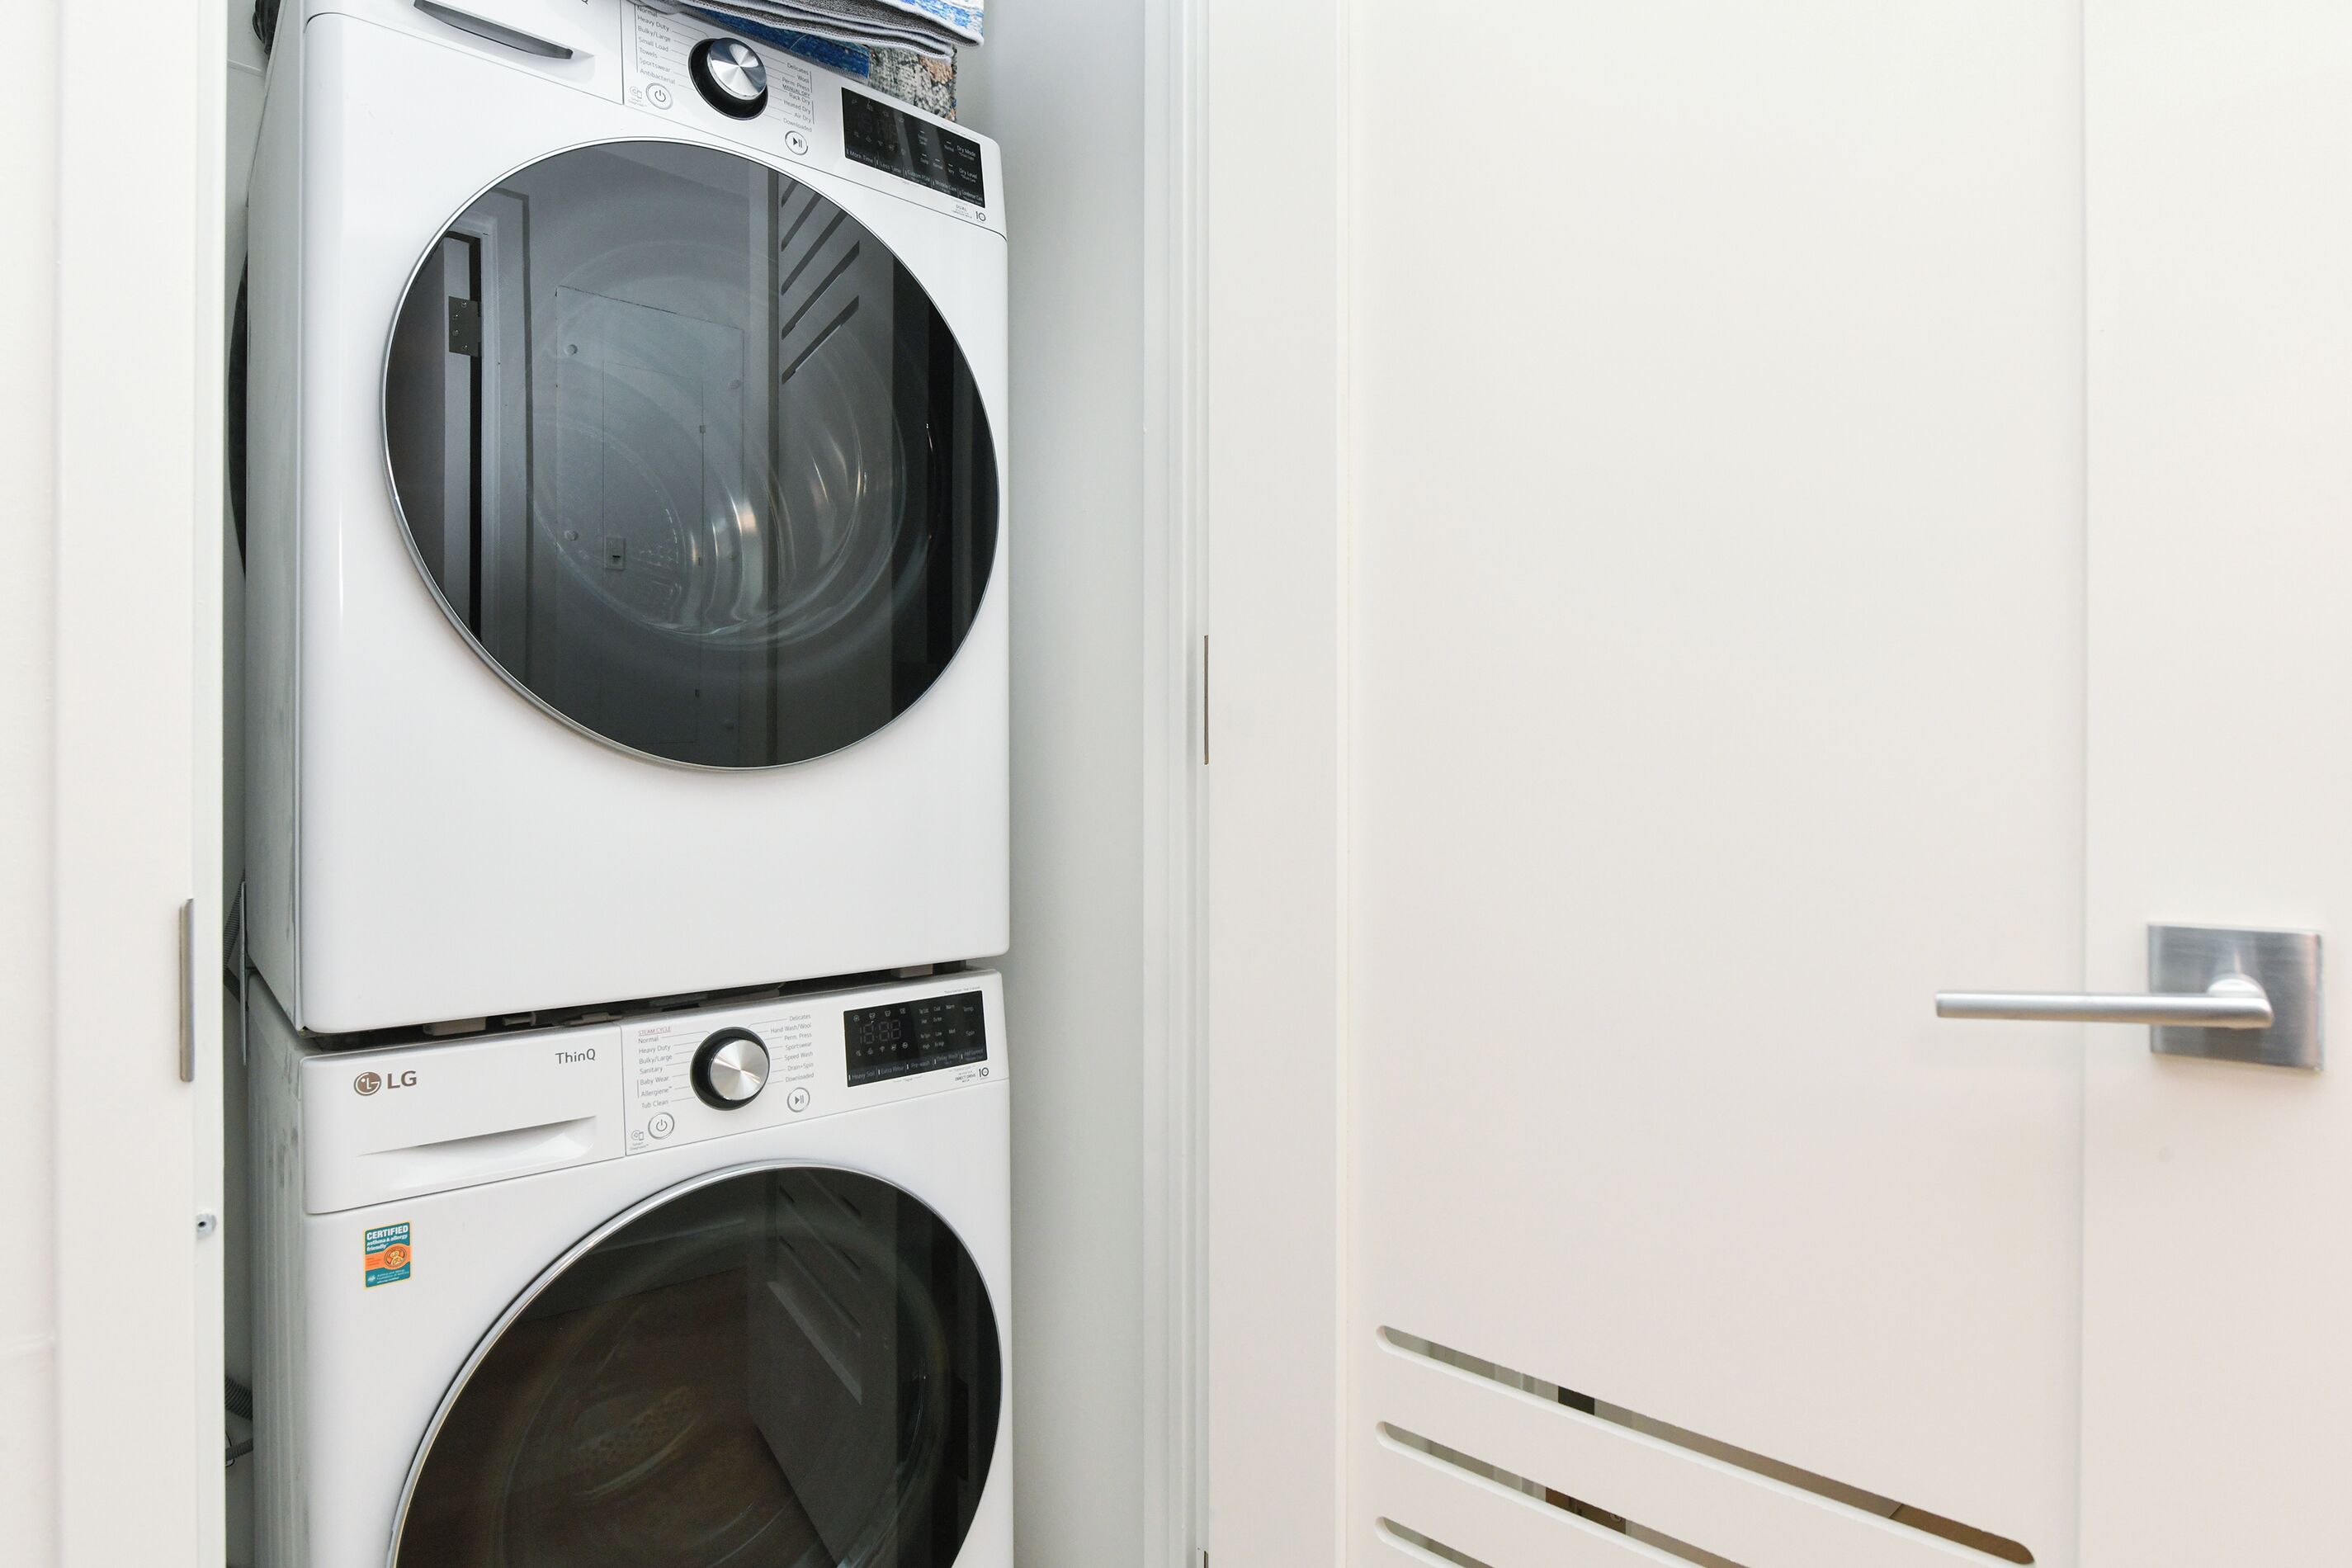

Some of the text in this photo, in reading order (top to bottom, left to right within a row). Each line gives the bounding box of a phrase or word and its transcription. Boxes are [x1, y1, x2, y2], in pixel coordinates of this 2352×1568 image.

[637, 5, 658, 17] Normal
[637, 15, 669, 32] Heavy Duty
[638, 26, 671, 42] Bulky/Large
[639, 37, 668, 52] Small Load
[640, 47, 657, 58] Towels
[640, 57, 670, 72] Sportswear
[786, 62, 809, 75] Delicates
[640, 68, 675, 84] Antibacterial
[797, 74, 810, 83] Wool
[797, 83, 810, 92] Press
[784, 100, 810, 115] Heated Dry
[801, 97, 810, 106] Dry
[783, 117, 812, 132] Downloaded
[803, 115, 811, 123] Dry
[785, 1023, 811, 1032] Wash/Wool
[638, 1036, 659, 1044] Normal
[786, 1042, 812, 1051] Sportswear
[555, 1048, 596, 1065] ThinQ
[639, 1055, 673, 1065] Bulky/Large
[786, 1072, 814, 1082] Downloaded
[979, 1067, 989, 1078] 10
[387, 1070, 417, 1089] LG
[366, 1225, 409, 1240] CERTIFIED
